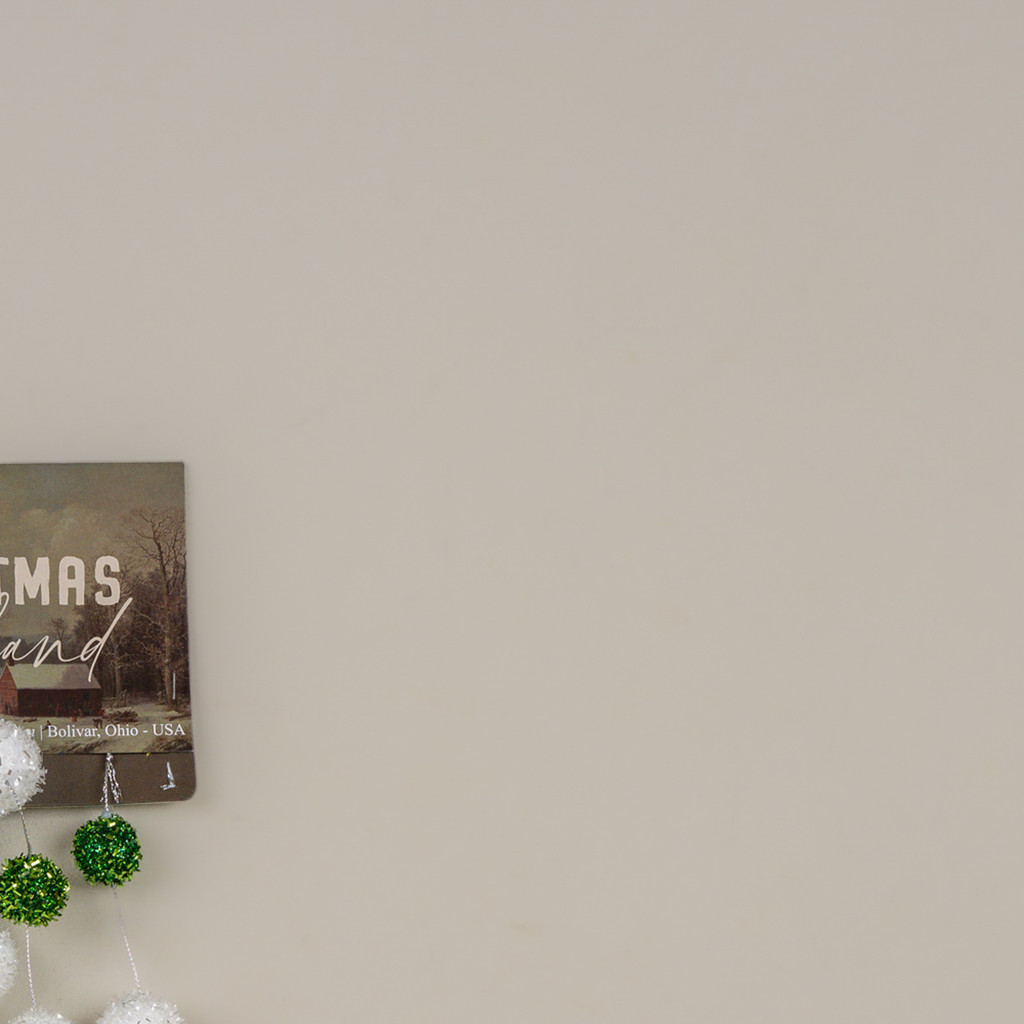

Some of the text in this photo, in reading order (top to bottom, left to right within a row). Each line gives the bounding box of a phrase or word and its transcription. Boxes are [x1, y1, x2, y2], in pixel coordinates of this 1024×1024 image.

[47, 724, 101, 739] Bolivar,
[104, 723, 139, 737] Ohio
[152, 723, 186, 736] USA
